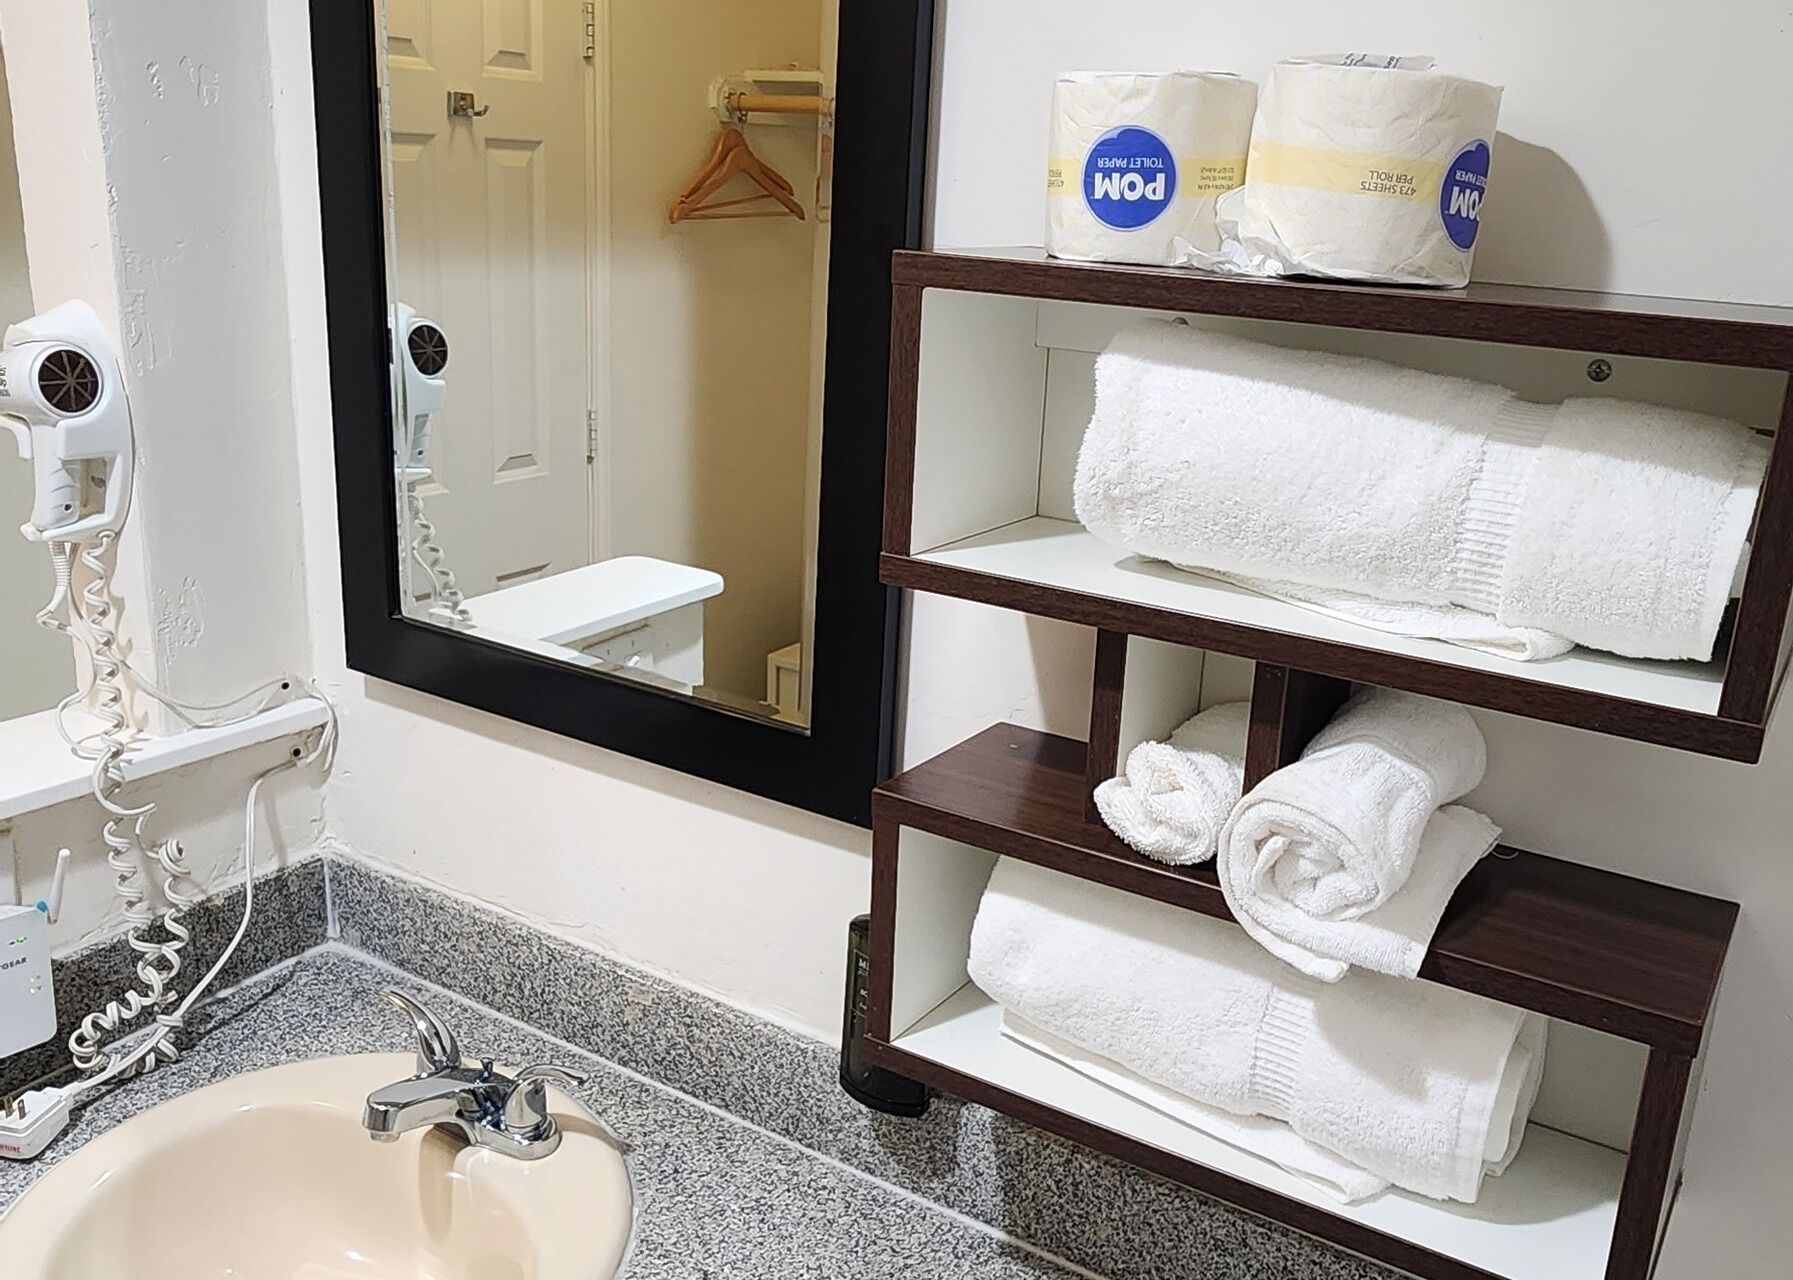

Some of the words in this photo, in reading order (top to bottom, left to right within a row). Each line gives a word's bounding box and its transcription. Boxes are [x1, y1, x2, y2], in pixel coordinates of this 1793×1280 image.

[1097, 157, 1127, 169] PAPER
[1128, 157, 1164, 169] TOILET
[1368, 170, 1394, 182] ROLL
[1395, 173, 1414, 185] PER
[1455, 169, 1477, 185] PAPER
[1094, 172, 1166, 201] POM
[1360, 180, 1398, 195] SHEETS
[1399, 185, 1417, 197] 473
[0, 956, 27, 970] GEAR
